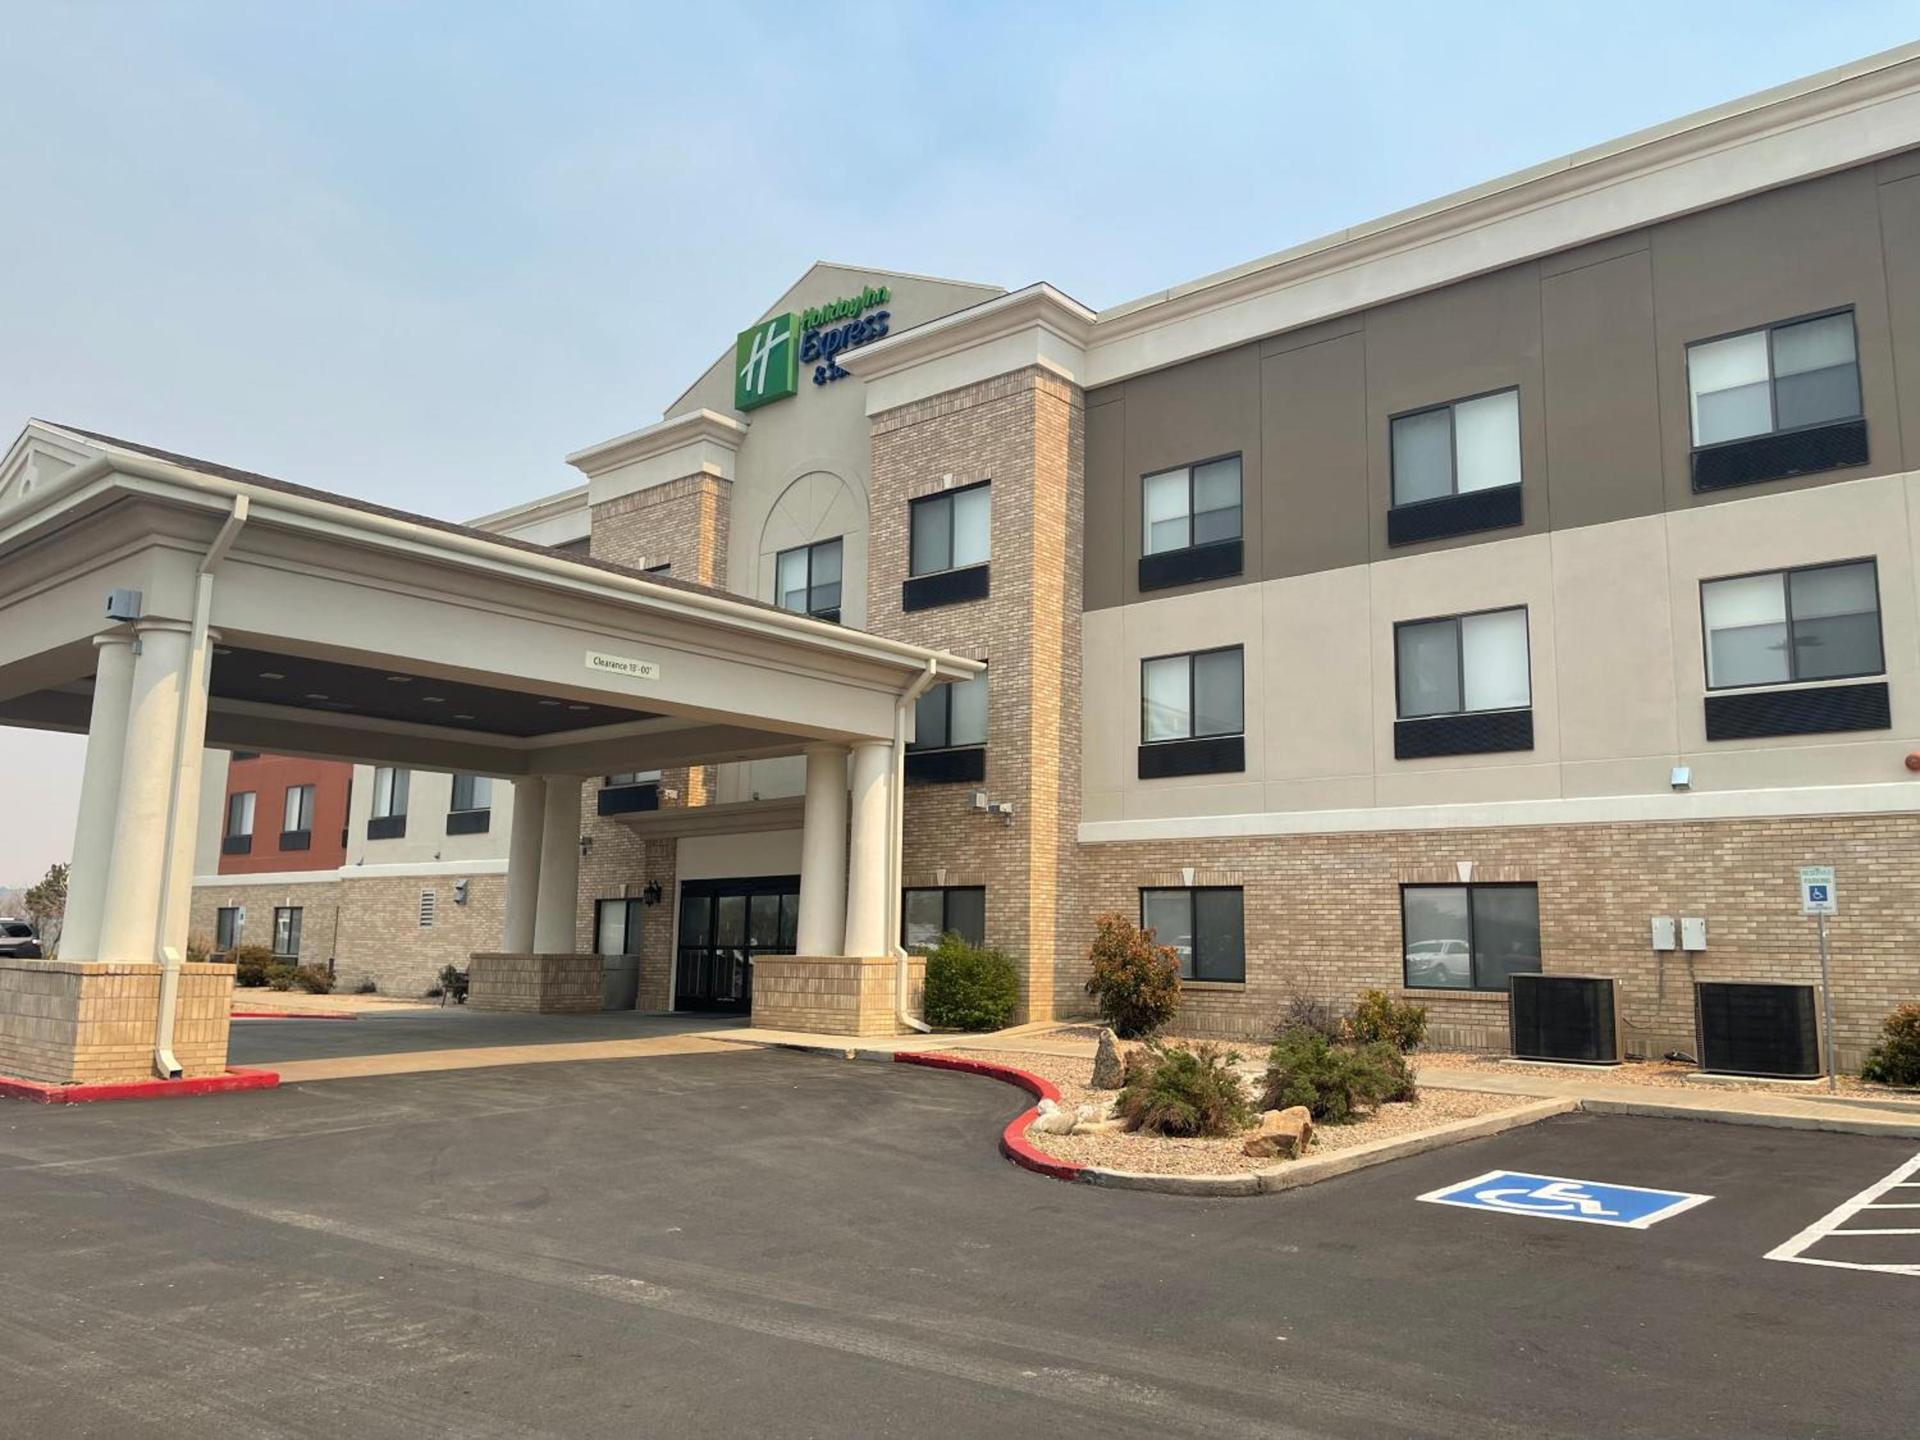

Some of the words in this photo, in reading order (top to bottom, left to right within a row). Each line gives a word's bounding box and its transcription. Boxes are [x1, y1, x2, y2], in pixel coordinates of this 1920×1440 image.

[801, 297, 863, 331] Holiday
[862, 285, 891, 309] Inn
[740, 322, 791, 395] H
[800, 311, 890, 363] Express
[813, 365, 827, 386] &
[593, 656, 628, 671] Clearance
